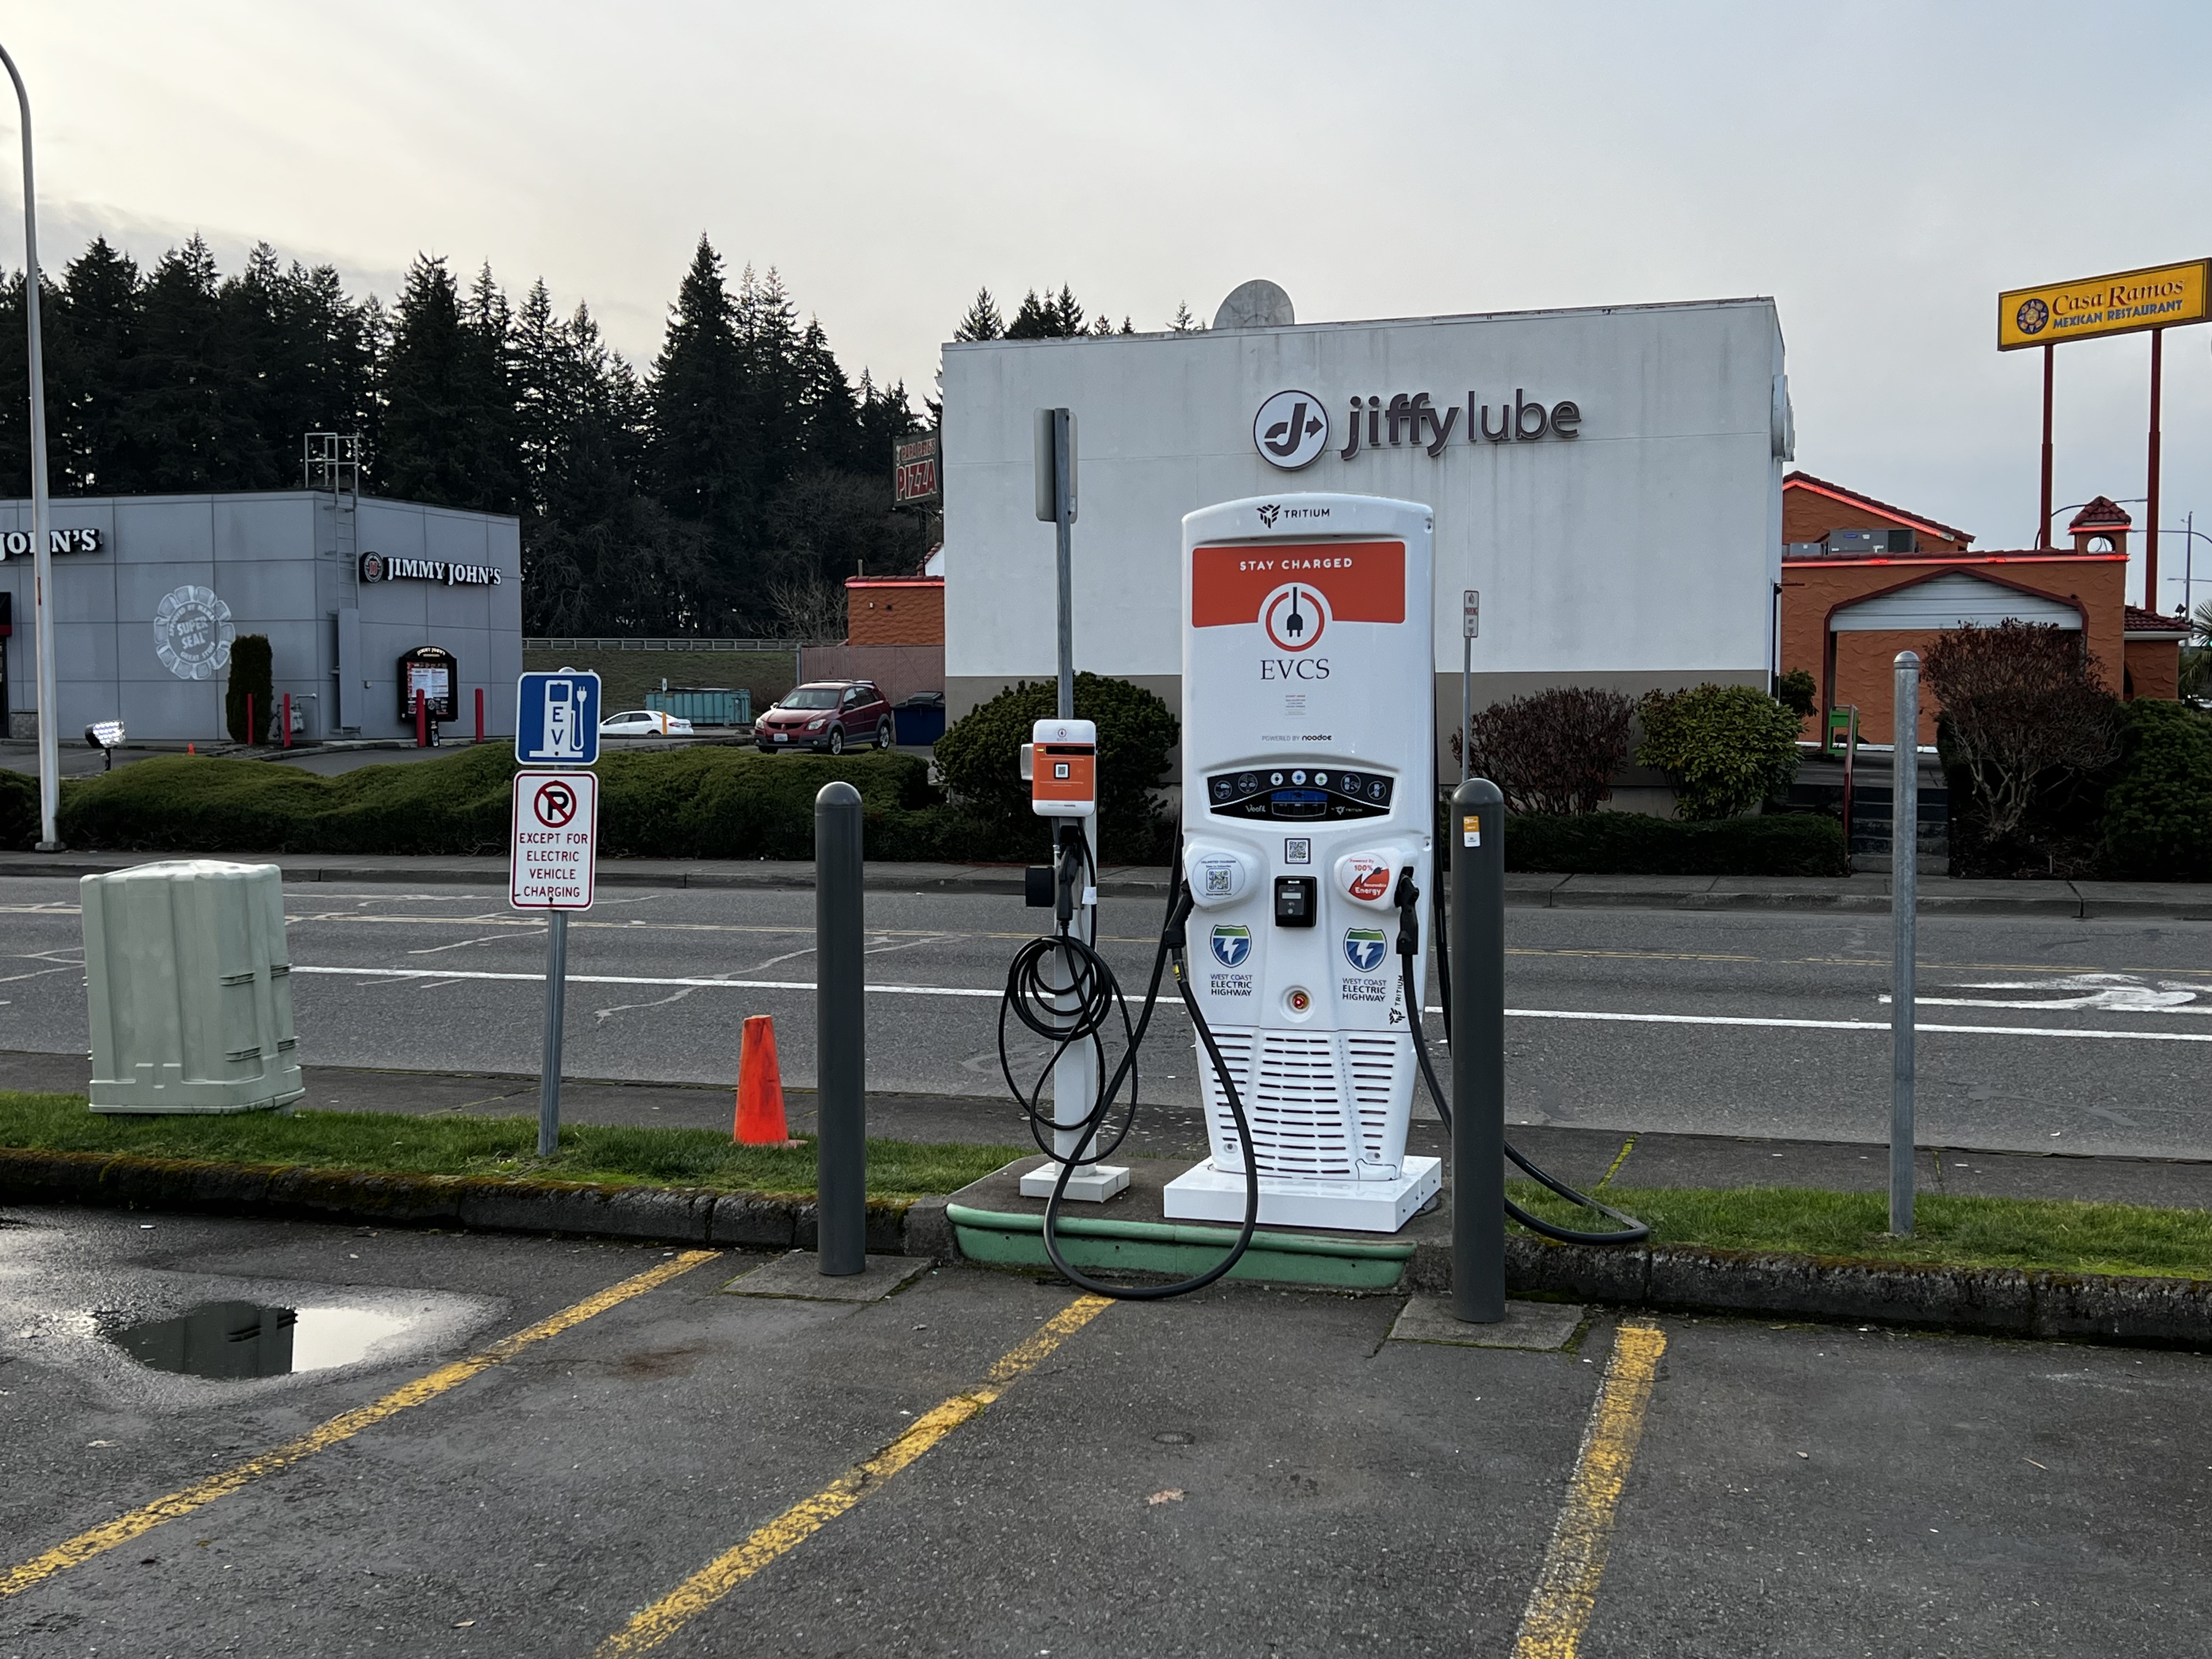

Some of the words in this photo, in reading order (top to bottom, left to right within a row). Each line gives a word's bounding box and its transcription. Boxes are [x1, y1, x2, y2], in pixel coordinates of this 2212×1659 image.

[2052, 293, 2103, 315] Casa
[2107, 279, 2186, 308] Ramos
[2053, 312, 2103, 329] MEXICAN
[2107, 299, 2183, 321] RESTAURANT
[1340, 392, 1462, 461] jiffy
[1468, 388, 1582, 442] lube
[896, 459, 938, 501] PIZZA
[1284, 509, 1330, 518] TRITIUM
[387, 557, 445, 581] JIMMY
[448, 563, 501, 586] JOHN'S
[1239, 560, 1274, 572] STAY
[1281, 557, 1353, 570] CHARGED
[177, 616, 208, 636] SUPER
[181, 631, 206, 650] SEAL
[1260, 658, 1330, 681] EVCS
[520, 833, 561, 844] EXCEPT
[567, 833, 588, 844] FOR
[527, 850, 579, 862] ELECTRIC
[529, 868, 576, 879] VEHICLE
[524, 886, 580, 898] CHARGING
[1355, 887, 1381, 896] Energy
[1211, 980, 1252, 989] ELECTRIC
[1342, 985, 1386, 994] ELECTRIC
[1395, 975, 1404, 1006] TRITIUM
[1342, 993, 1386, 1002] HIGHWAY
